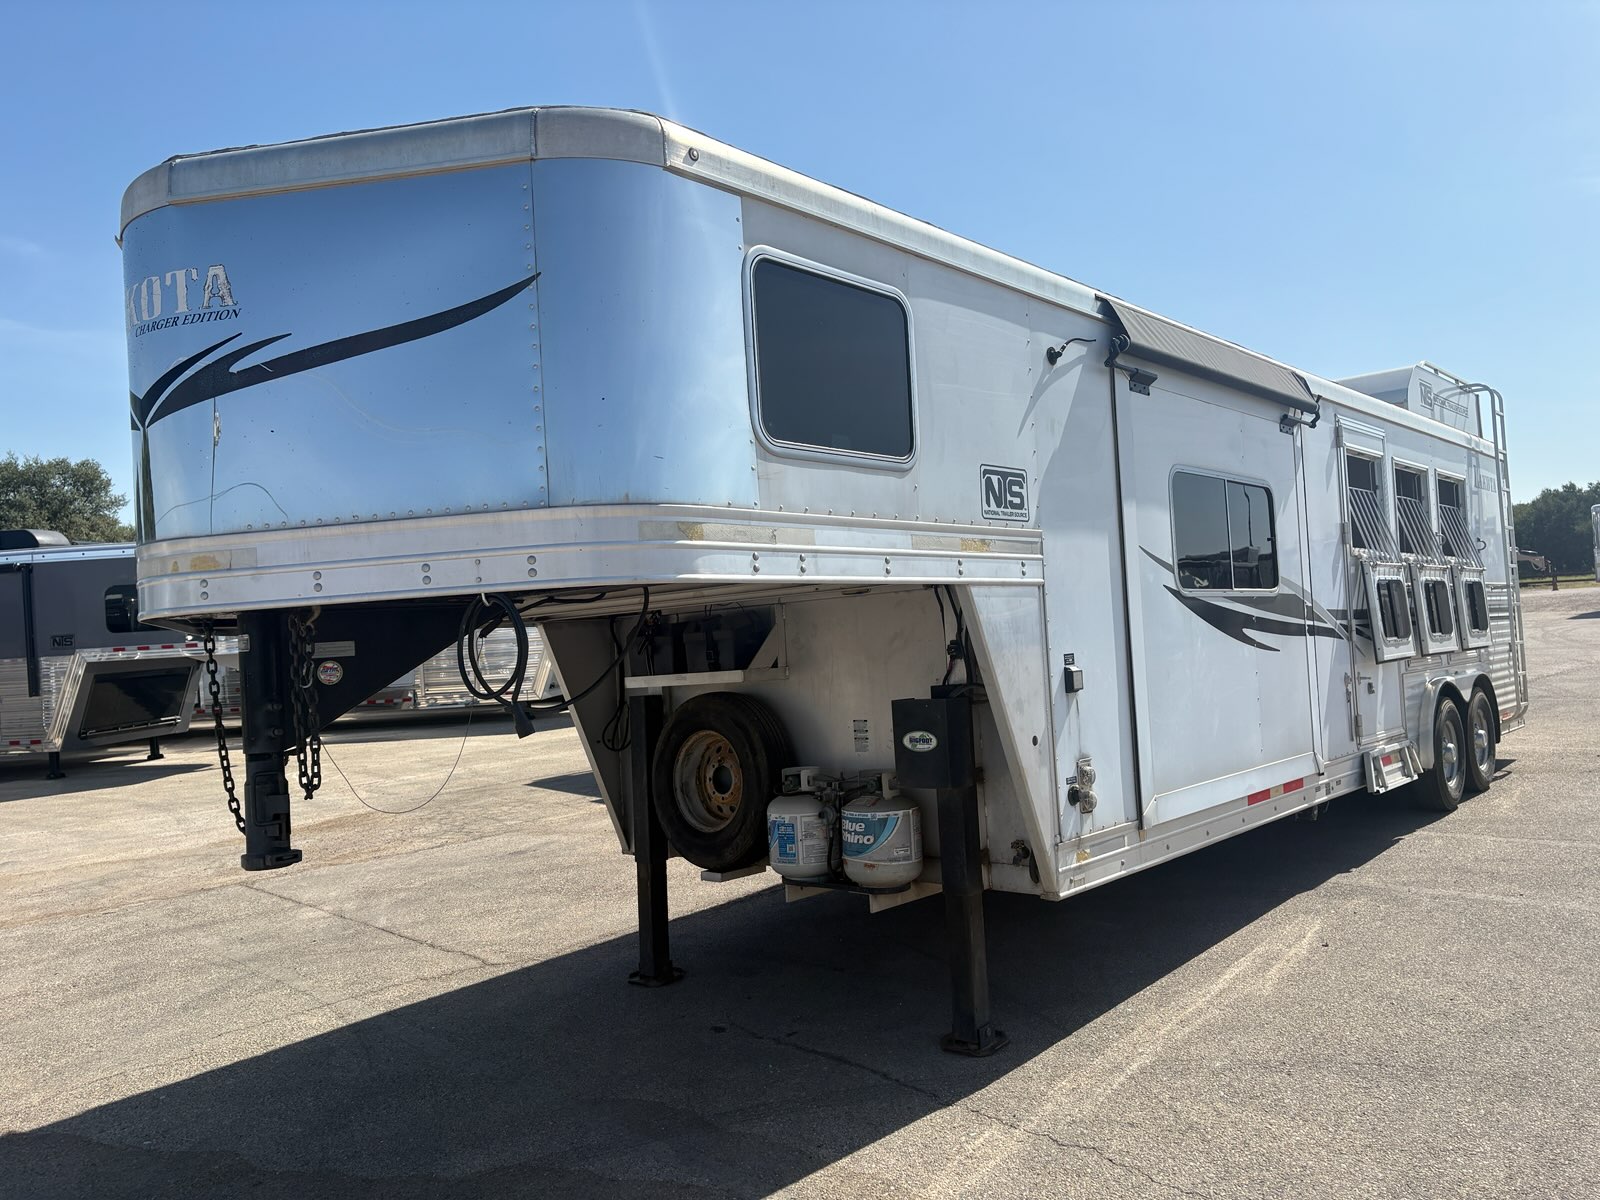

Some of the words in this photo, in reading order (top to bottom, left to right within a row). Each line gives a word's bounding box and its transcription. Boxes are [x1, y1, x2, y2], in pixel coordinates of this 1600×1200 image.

[135, 315, 180, 338] CHARGER
[181, 308, 241, 326] EDITION
[983, 469, 1026, 511] NTS
[51, 634, 74, 647] NTS
